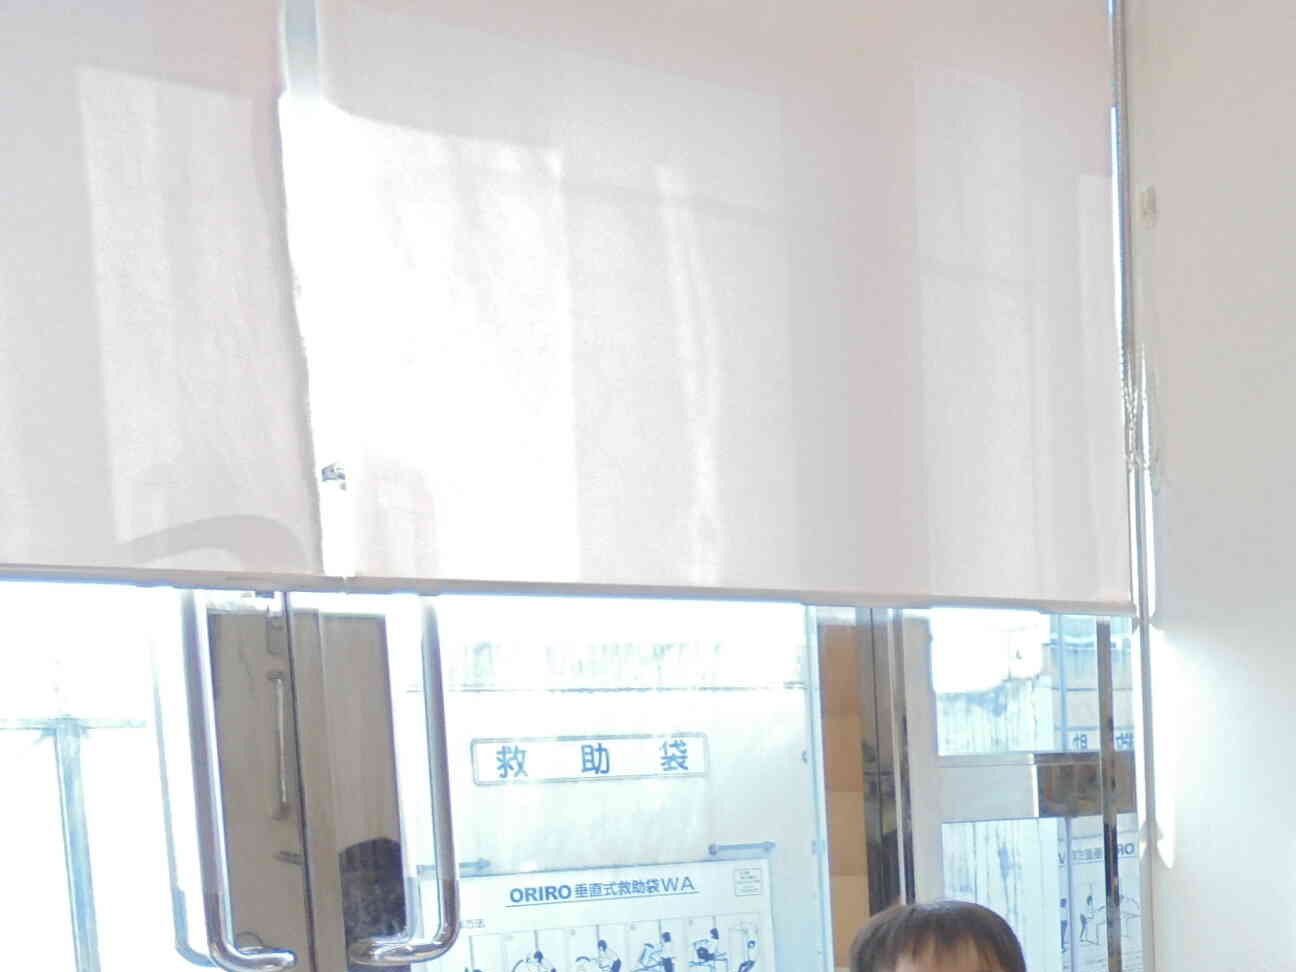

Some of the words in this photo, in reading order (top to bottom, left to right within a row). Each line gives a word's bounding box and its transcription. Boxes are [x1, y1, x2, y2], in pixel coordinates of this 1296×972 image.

[496, 740, 688, 778] 救助袋
[509, 885, 572, 904] ORIRO
